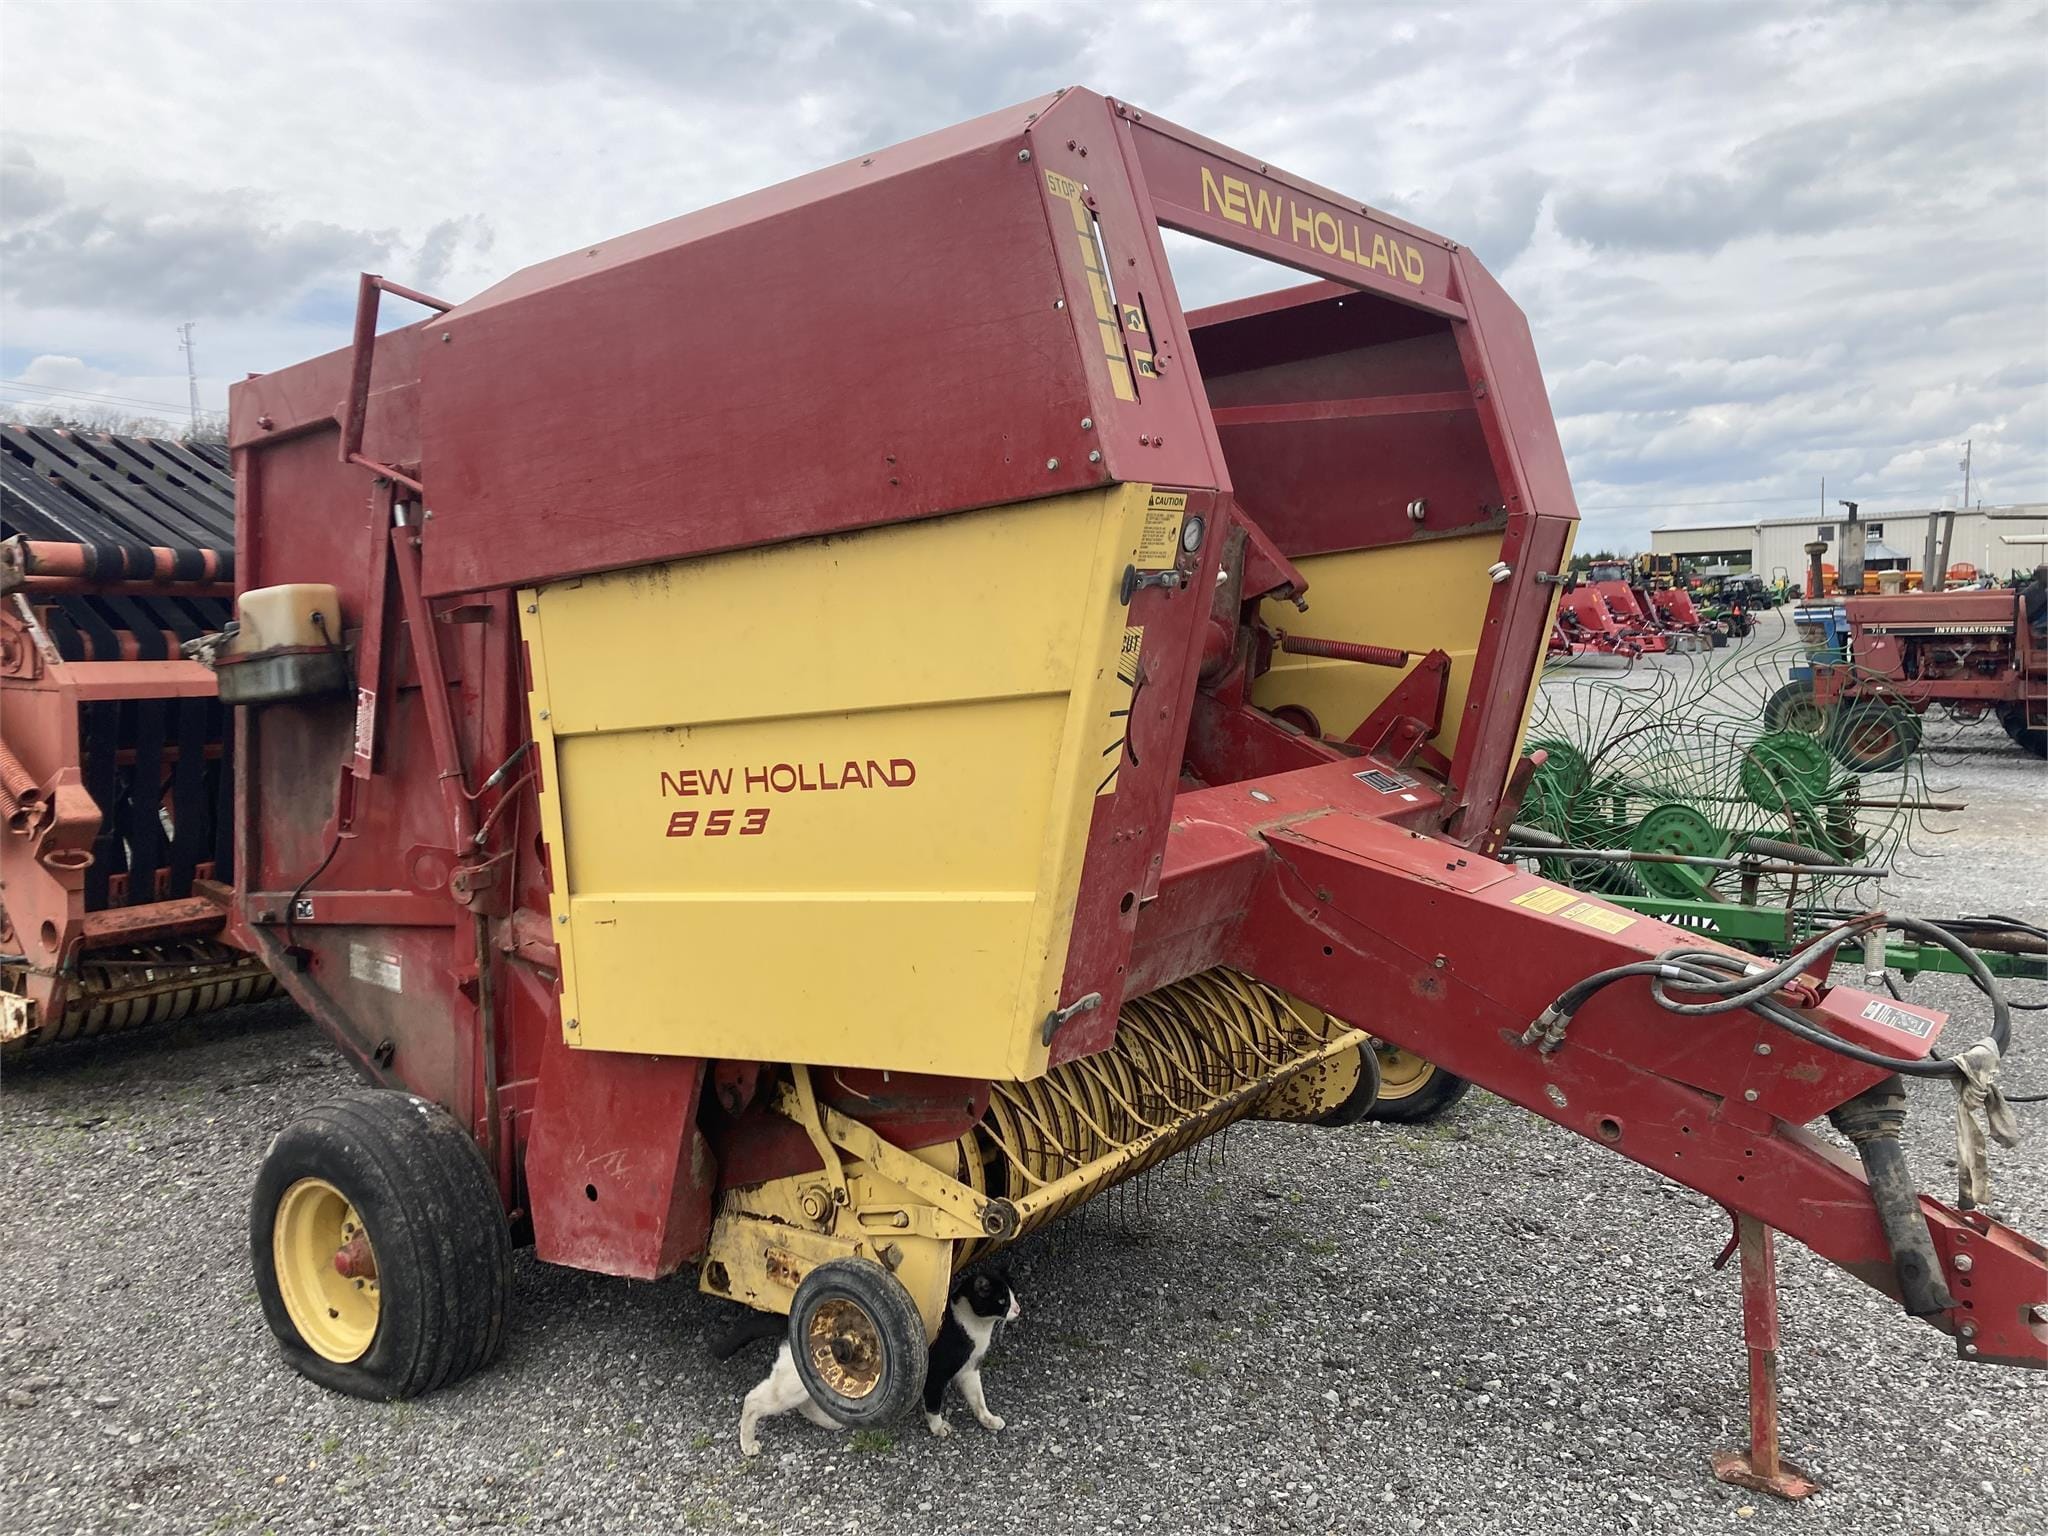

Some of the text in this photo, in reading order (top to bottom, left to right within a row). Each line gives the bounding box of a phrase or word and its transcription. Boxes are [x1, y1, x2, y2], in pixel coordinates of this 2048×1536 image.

[1047, 174, 1076, 198] STOP
[1201, 167, 1424, 285] NEW HOLLAND
[1155, 496, 1184, 507] CAUTION
[660, 759, 916, 796] NEW HOLLAND
[666, 808, 770, 837] 853
